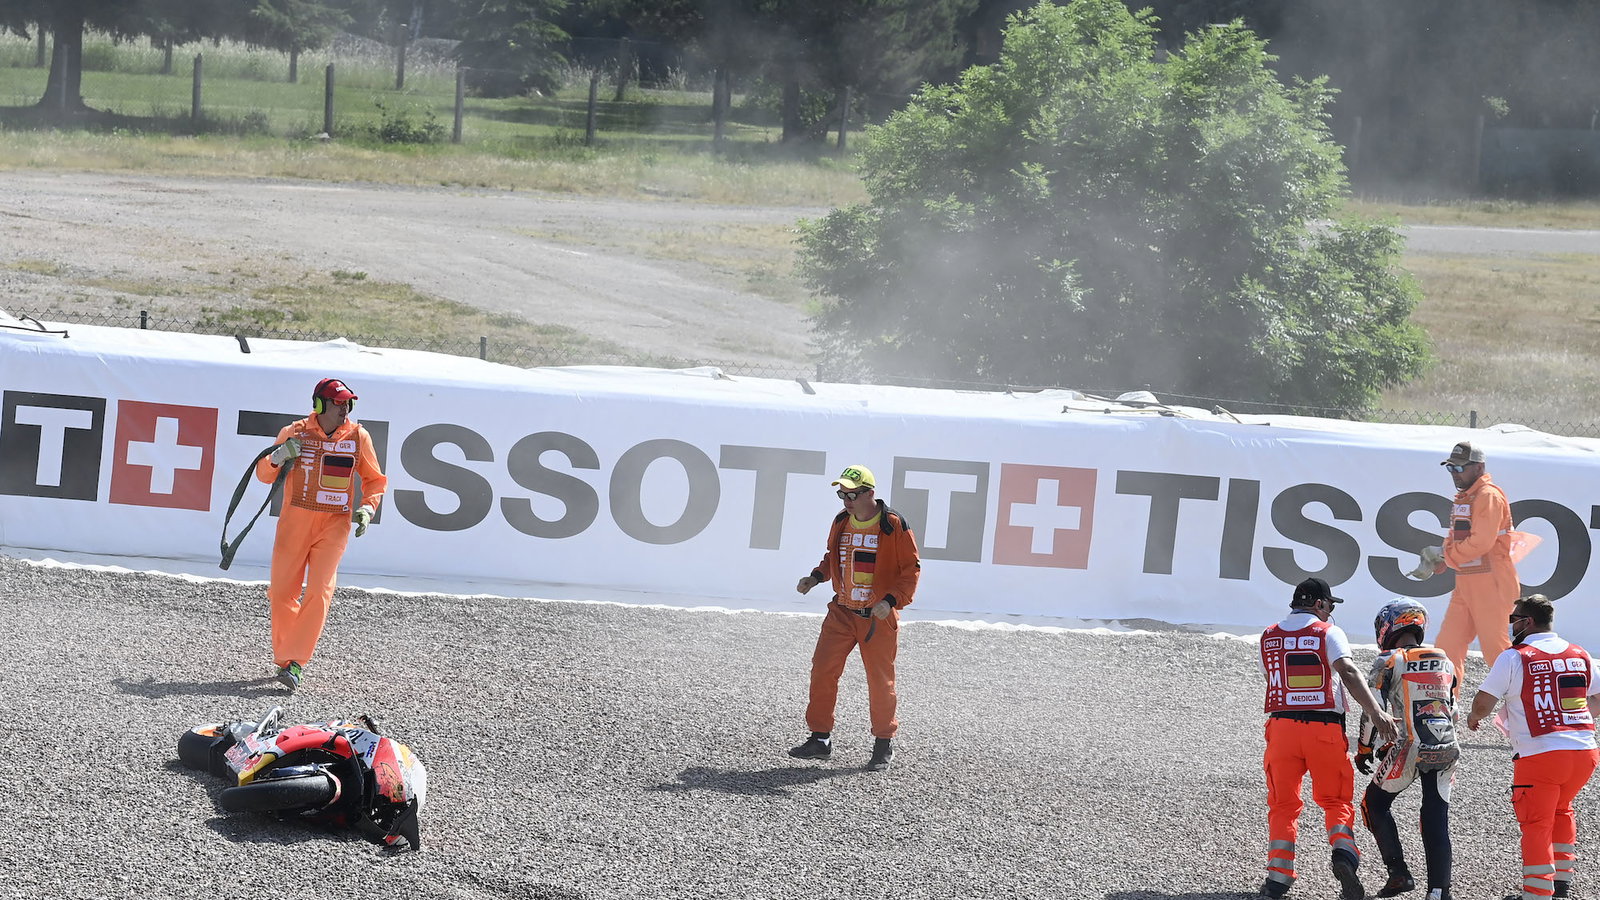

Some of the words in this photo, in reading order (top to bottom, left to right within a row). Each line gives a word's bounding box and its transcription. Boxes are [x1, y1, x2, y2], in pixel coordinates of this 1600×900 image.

[1115, 469, 1600, 602] TISSO
[1266, 640, 1280, 648] 2021
[1406, 660, 1450, 673] REPSO
[1532, 663, 1549, 672] 2021
